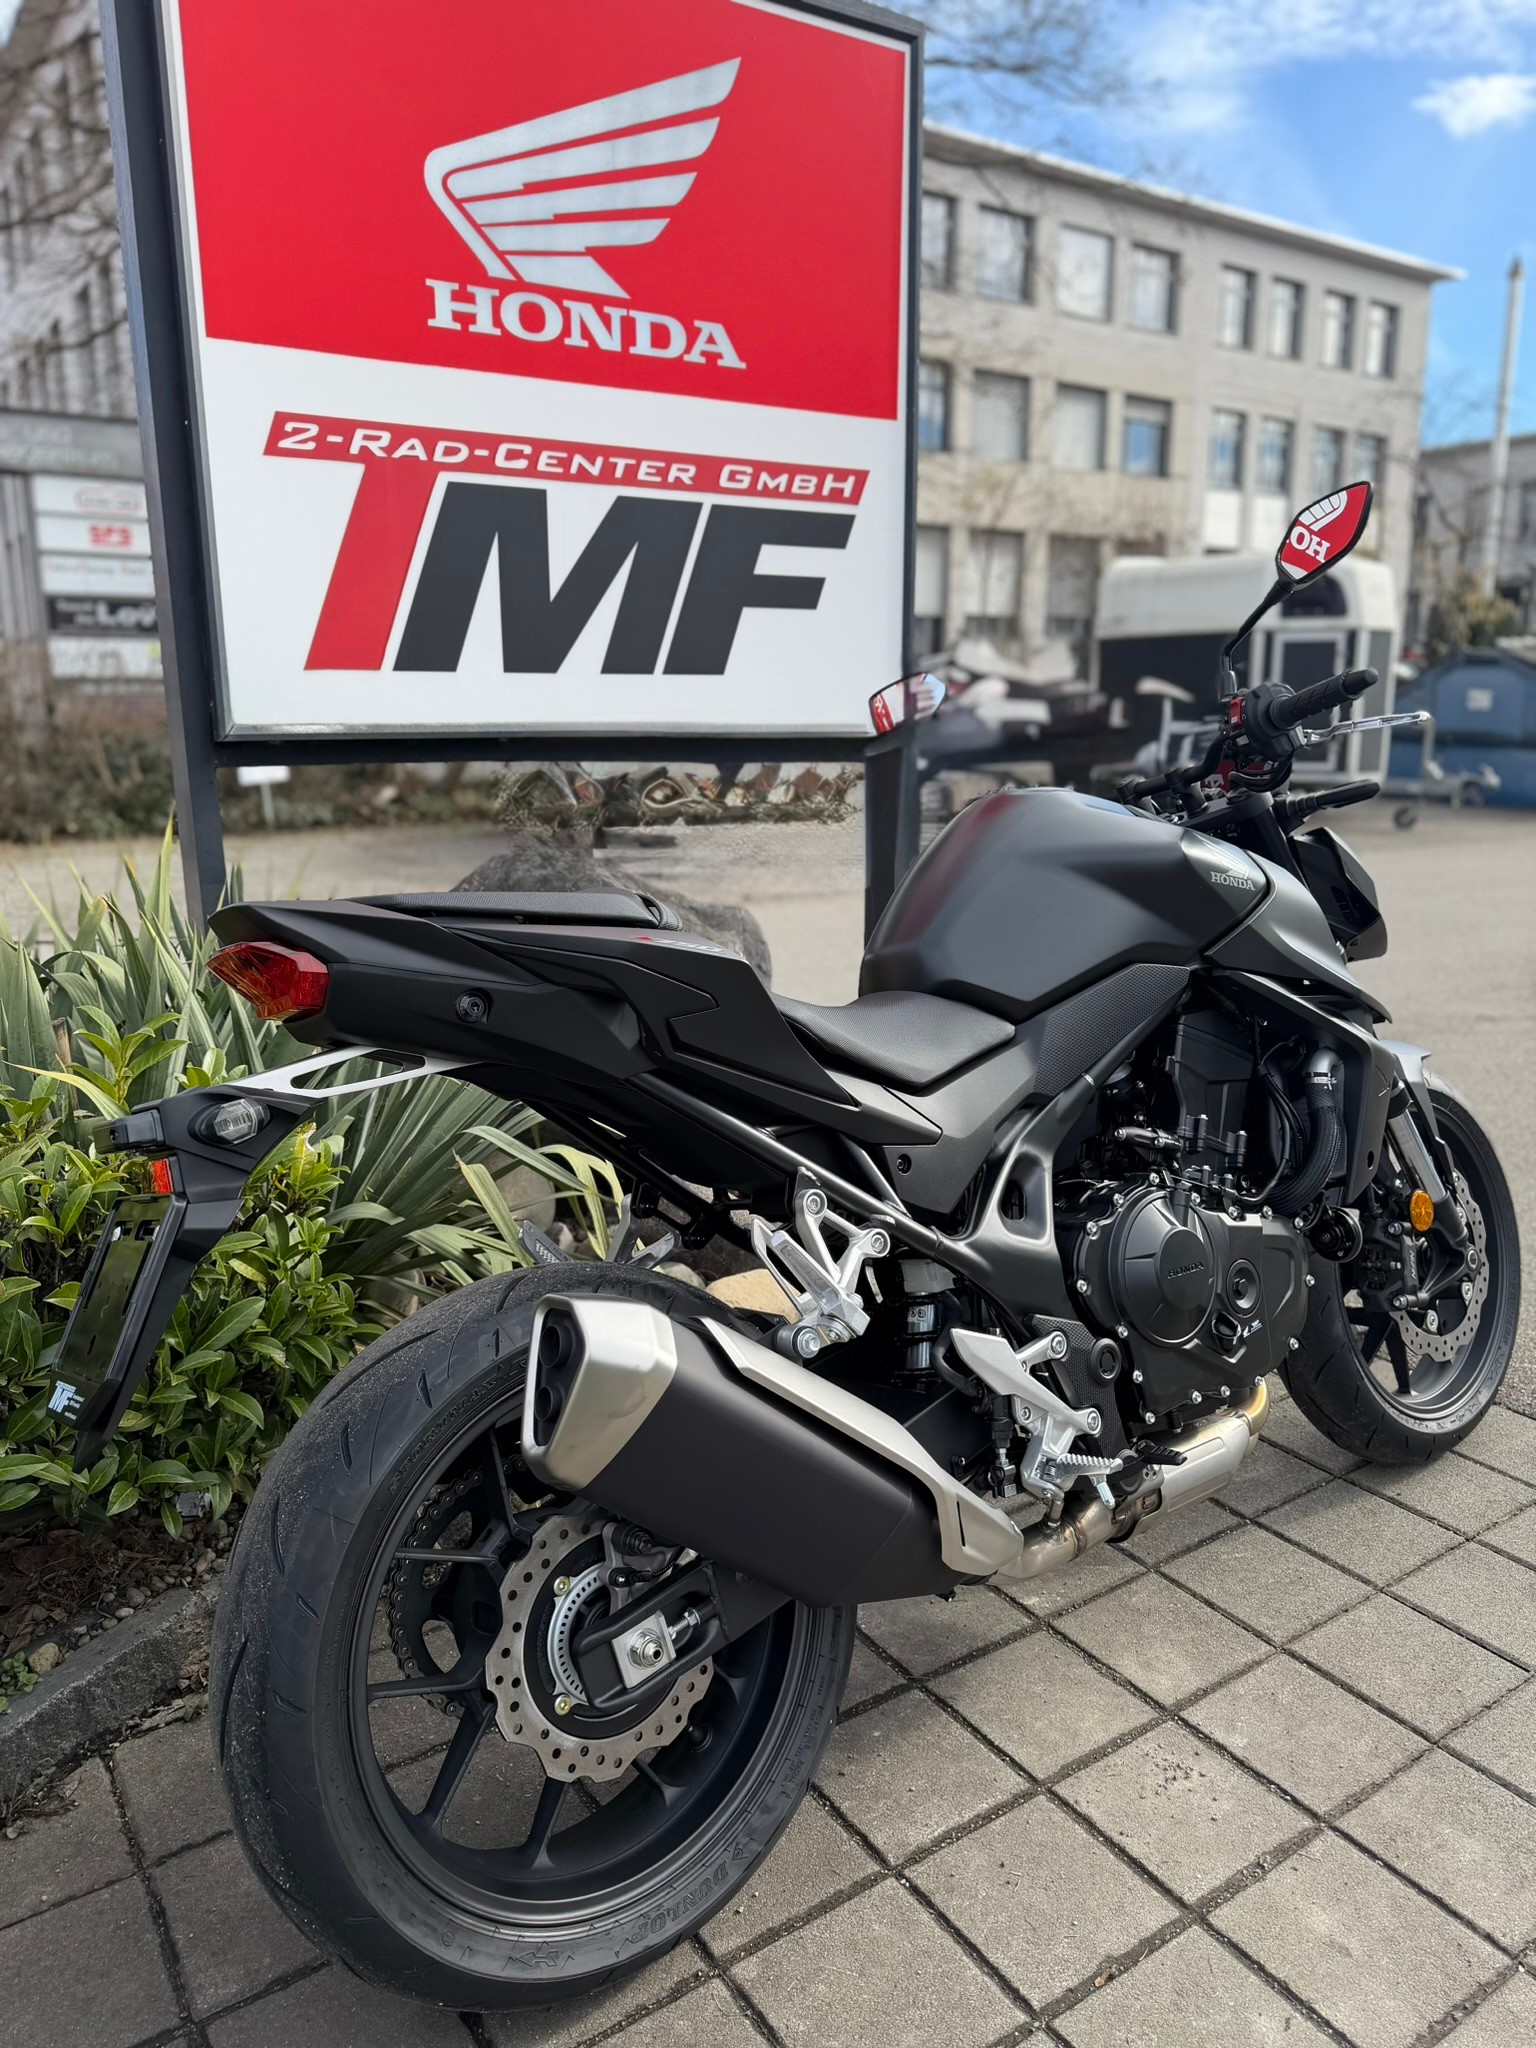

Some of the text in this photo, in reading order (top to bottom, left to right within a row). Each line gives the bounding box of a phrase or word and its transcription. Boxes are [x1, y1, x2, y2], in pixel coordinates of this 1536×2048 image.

[425, 278, 746, 369] HONDA
[290, 455, 857, 675] TMF
[1210, 871, 1255, 891] HONDA
[1167, 1261, 1205, 1279] HONDA
[630, 1860, 729, 1944] DUNLOP
